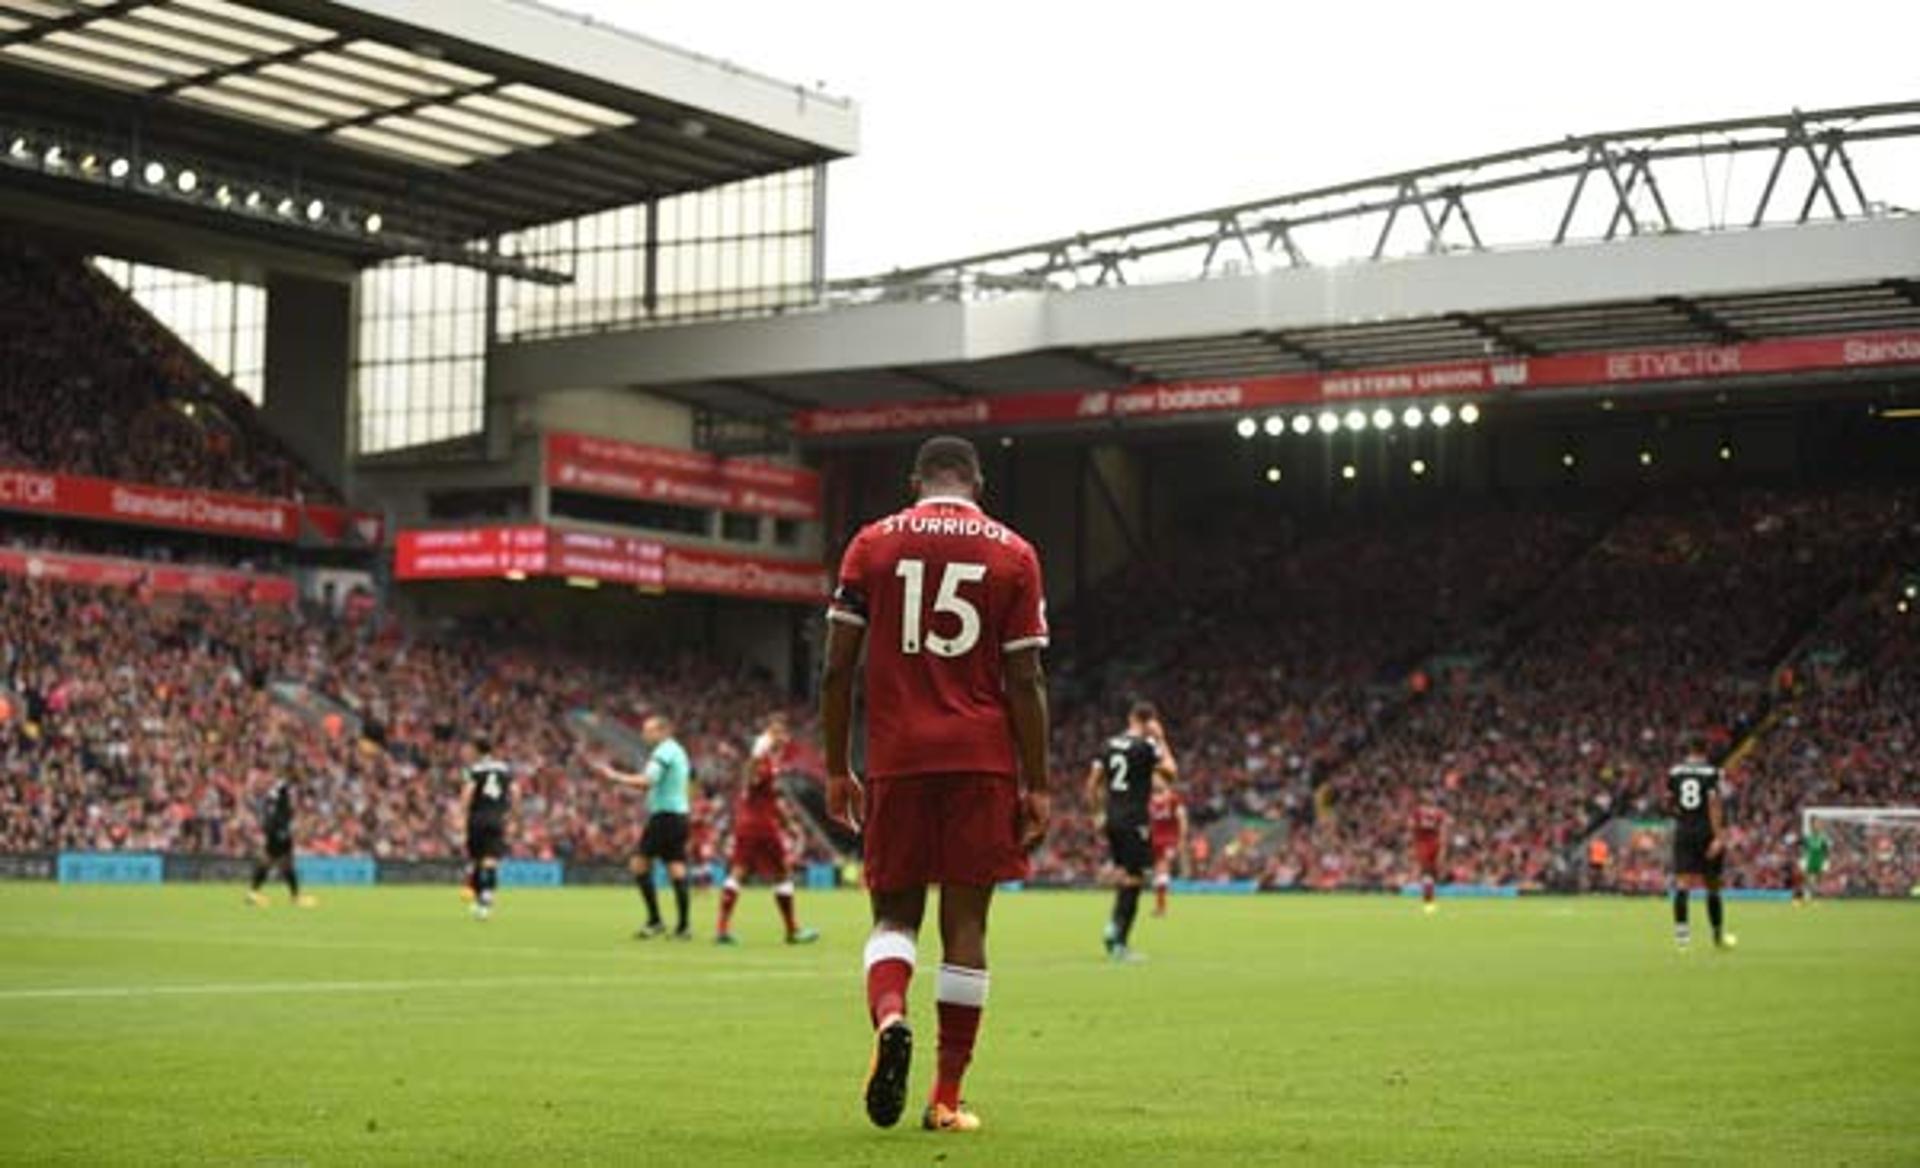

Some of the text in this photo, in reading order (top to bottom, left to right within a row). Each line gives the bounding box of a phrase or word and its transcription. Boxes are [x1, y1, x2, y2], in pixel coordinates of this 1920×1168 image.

[1606, 348, 1740, 379] BETVICTOR
[1322, 373, 1412, 395] WESTERN
[1417, 368, 1483, 389] UNION
[1113, 392, 1153, 413] new
[1157, 384, 1243, 411] balance
[881, 513, 1014, 545] STURRIDGE
[895, 558, 987, 658] 15
[1109, 753, 1129, 791] 2
[1680, 778, 1701, 809] 8
